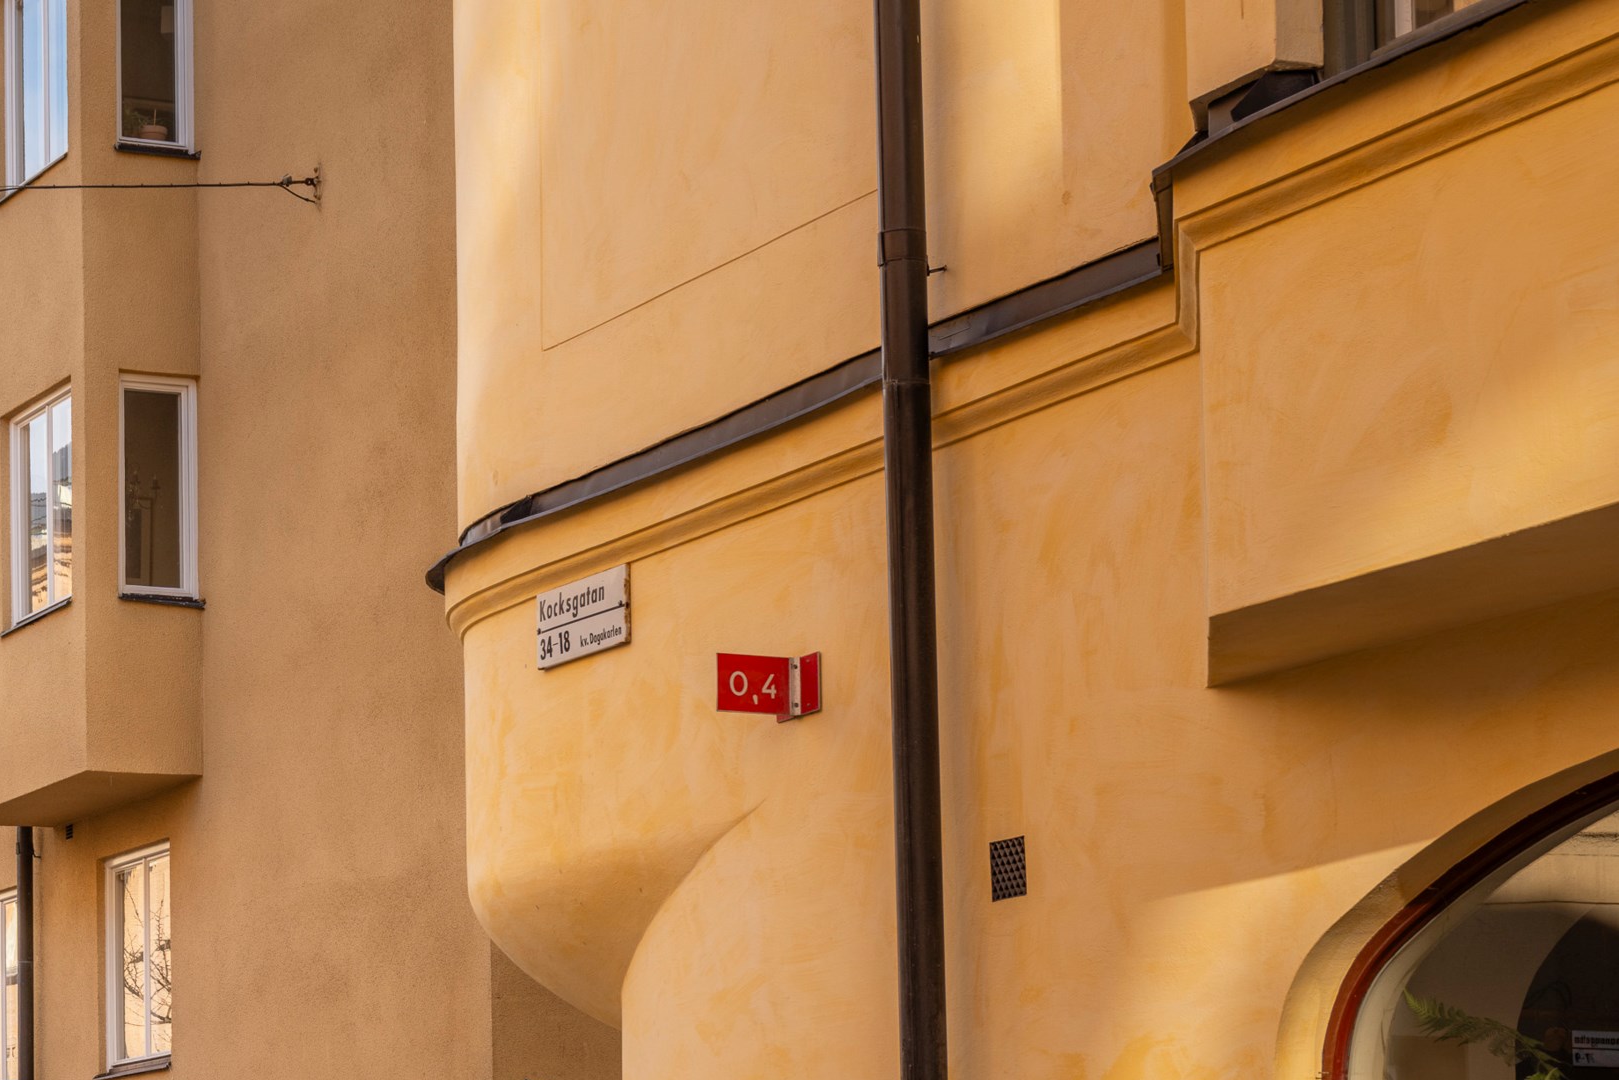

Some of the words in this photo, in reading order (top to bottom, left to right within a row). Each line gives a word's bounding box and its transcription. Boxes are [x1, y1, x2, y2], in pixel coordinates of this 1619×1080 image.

[540, 586, 605, 622] Kocksgatan
[540, 630, 571, 660] 34-18
[729, 670, 777, 705] 0,4
